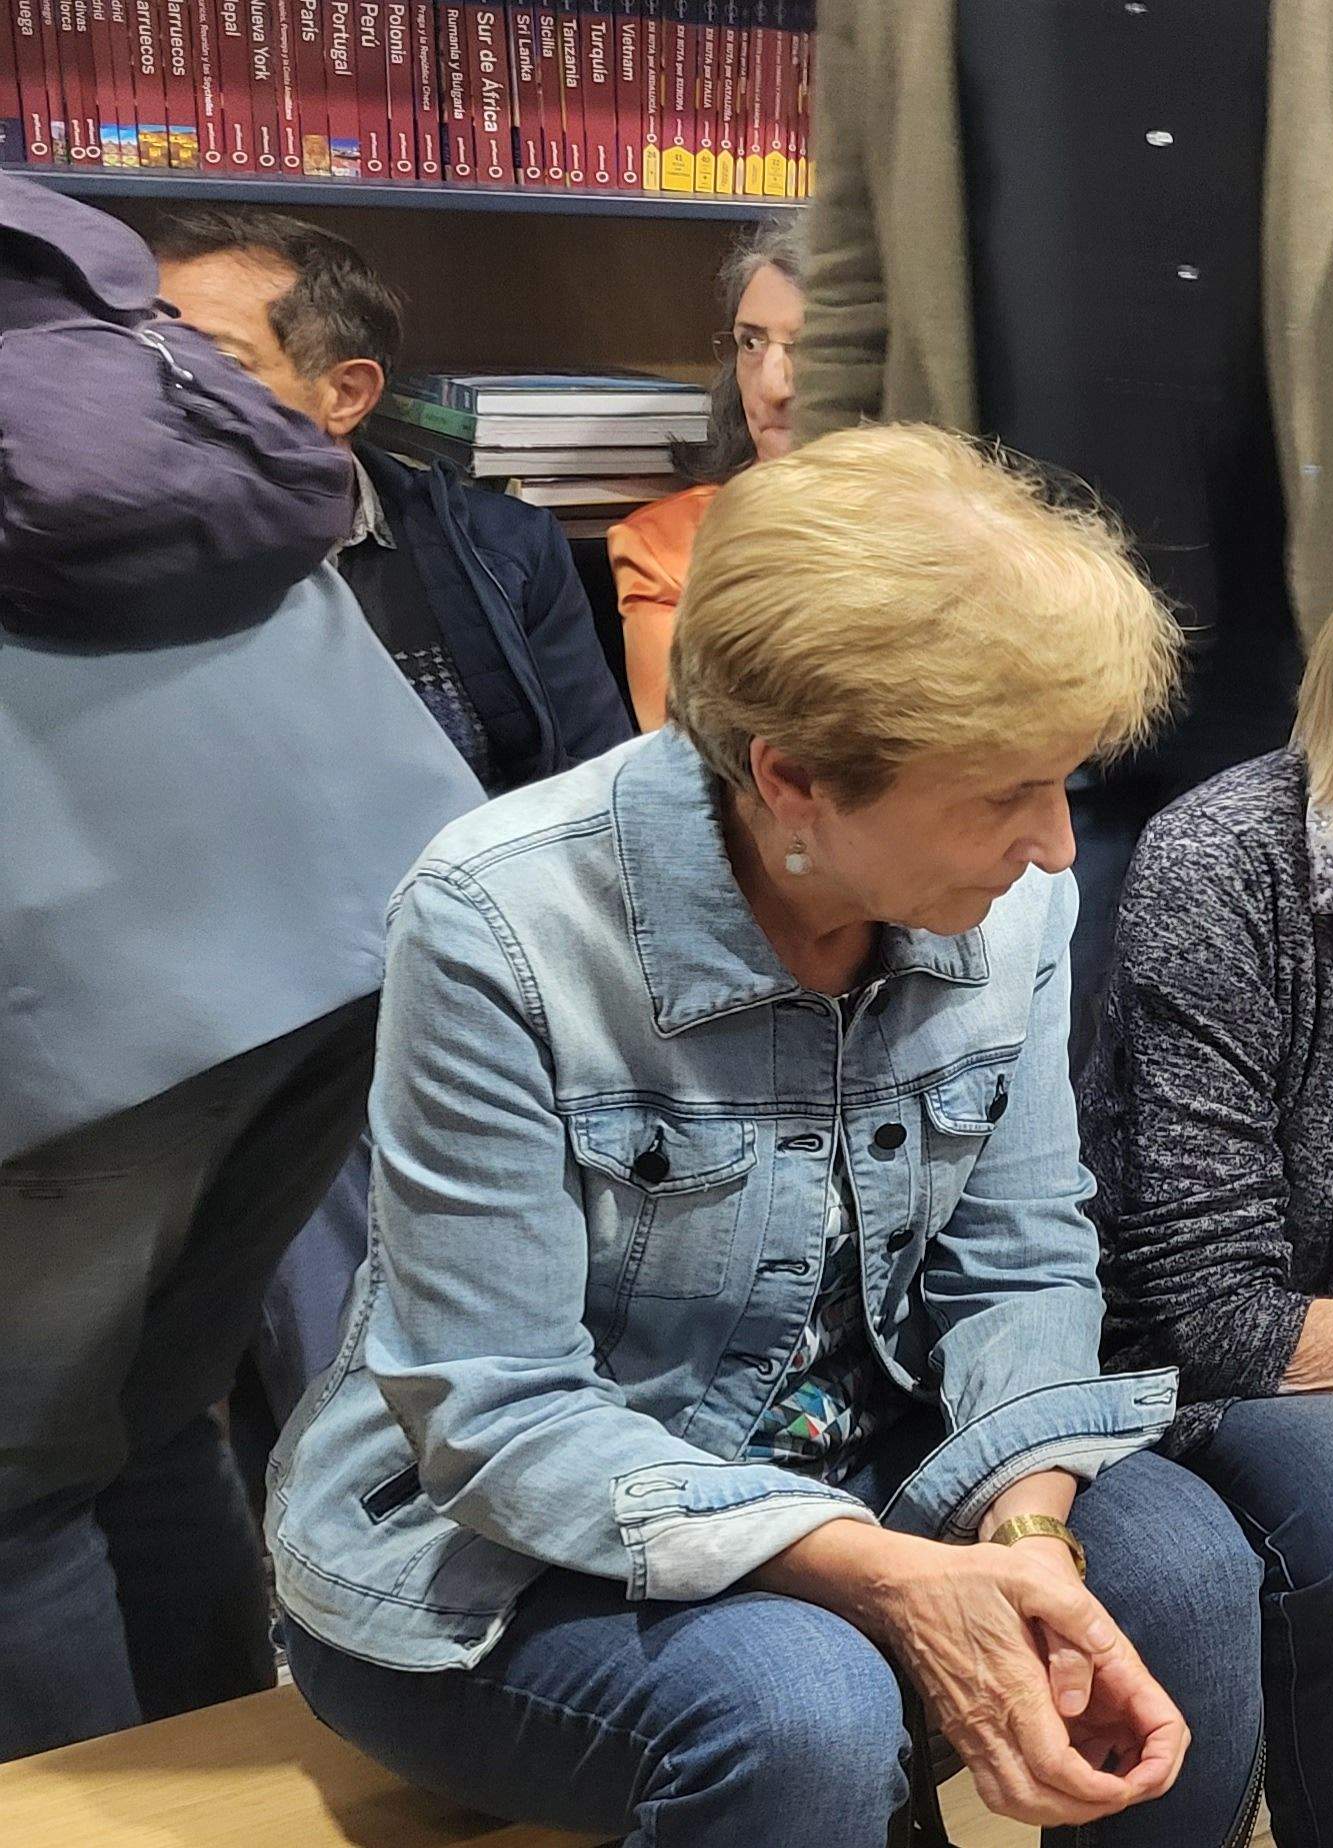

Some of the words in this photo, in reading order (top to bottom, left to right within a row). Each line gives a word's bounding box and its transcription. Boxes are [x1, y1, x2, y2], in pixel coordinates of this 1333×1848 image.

[300, 0, 319, 42] París
[330, 2, 352, 76] Portugal
[360, 3, 380, 48] Perú
[388, 4, 406, 65] Polonia
[476, 11, 495, 46] Sur
[516, 14, 530, 37] Sri
[540, 15, 556, 58] Sicilia
[253, 47, 271, 81] York
[479, 49, 498, 73] de
[518, 38, 537, 82] Lanka
[562, 19, 580, 88] Tanzania
[589, 22, 608, 83] Turquía
[622, 24, 637, 81] Vietnam
[450, 72, 466, 120] Bulgaria
[480, 77, 504, 133] África
